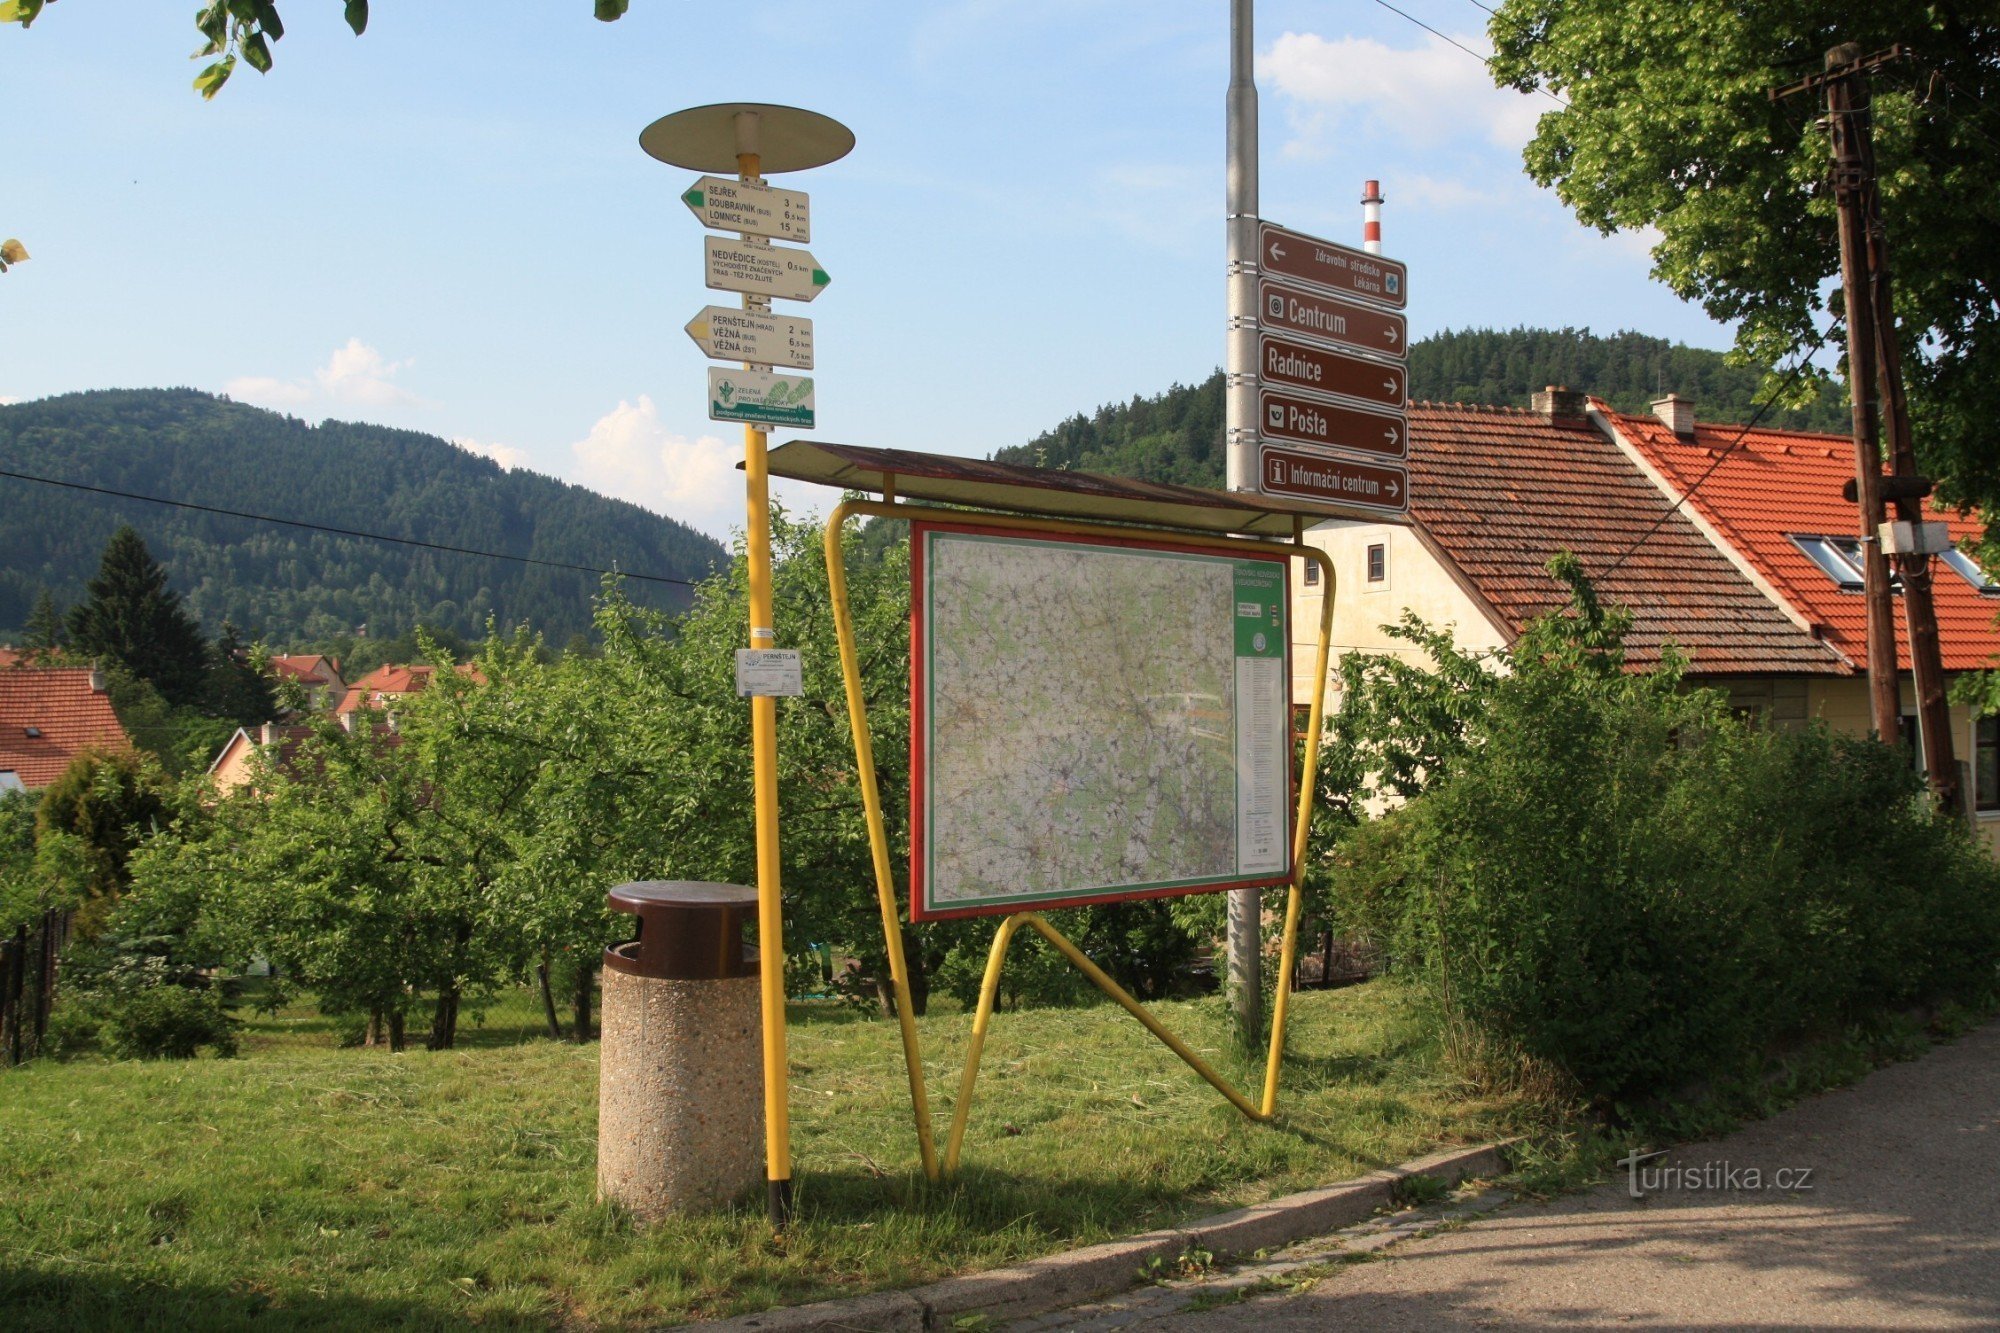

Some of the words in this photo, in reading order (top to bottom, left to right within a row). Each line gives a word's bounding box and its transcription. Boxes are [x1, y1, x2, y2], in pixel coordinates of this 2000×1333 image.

[709, 186, 737, 198] SEJŘEK
[784, 199, 790, 207] 3
[709, 198, 756, 214] DOUBRAVNÍK
[756, 208, 772, 217] (BUS)
[784, 211, 796, 220] 6,5
[709, 210, 742, 224] LOMNICE
[743, 218, 758, 227] (BUS)
[780, 222, 790, 232] 15
[712, 249, 756, 264] NEDVĚDICE
[756, 258, 781, 268] (KOSTEL)
[787, 261, 798, 271] 0,5
[749, 265, 783, 277] ZNAČENÝCH
[1315, 248, 1347, 268] Zdravotní
[1350, 259, 1380, 278] středisko
[713, 268, 729, 277] TRAS
[1354, 275, 1380, 293] Lékárna
[713, 315, 755, 329] PERNŠTEJN
[755, 323, 775, 333] (HRAD)
[789, 326, 794, 334] 2
[1289, 298, 1347, 335] Centrum
[713, 327, 741, 339] VĚŽNÁ
[742, 334, 757, 342] (BUS)
[789, 338, 800, 348] 6,5
[801, 341, 811, 349] km
[713, 340, 741, 352] VĚŽNÁ
[790, 350, 800, 360] 7,5
[801, 353, 811, 361] km
[1268, 347, 1322, 382] Radnice
[738, 386, 761, 395] ZELENÁ
[767, 413, 800, 424] turistických
[1289, 406, 1327, 436] Pošta
[1291, 464, 1340, 490] Informační
[1342, 476, 1379, 496] centrum
